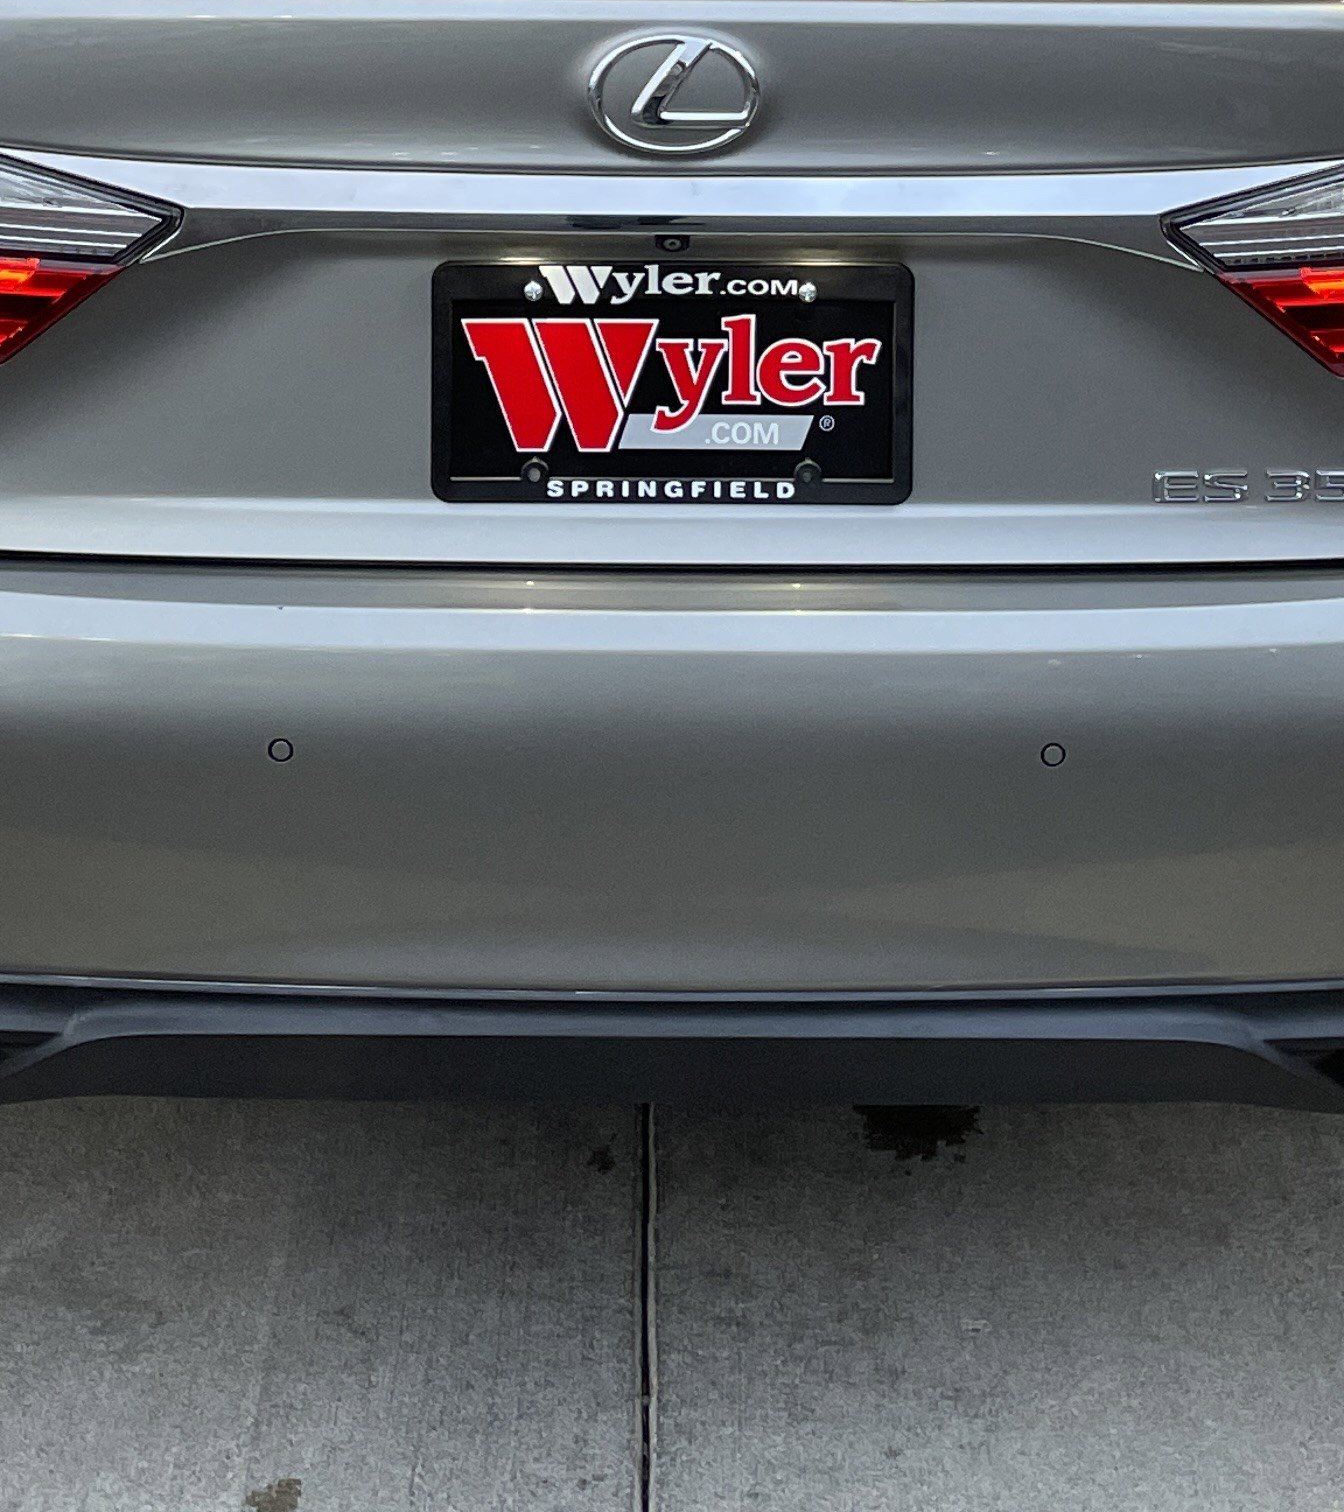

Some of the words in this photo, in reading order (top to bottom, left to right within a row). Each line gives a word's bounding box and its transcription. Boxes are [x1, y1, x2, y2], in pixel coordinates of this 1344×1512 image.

[460, 314, 882, 453] Wyler
[547, 480, 795, 499] SPRINGFIELD
[1153, 468, 1248, 502] ES
